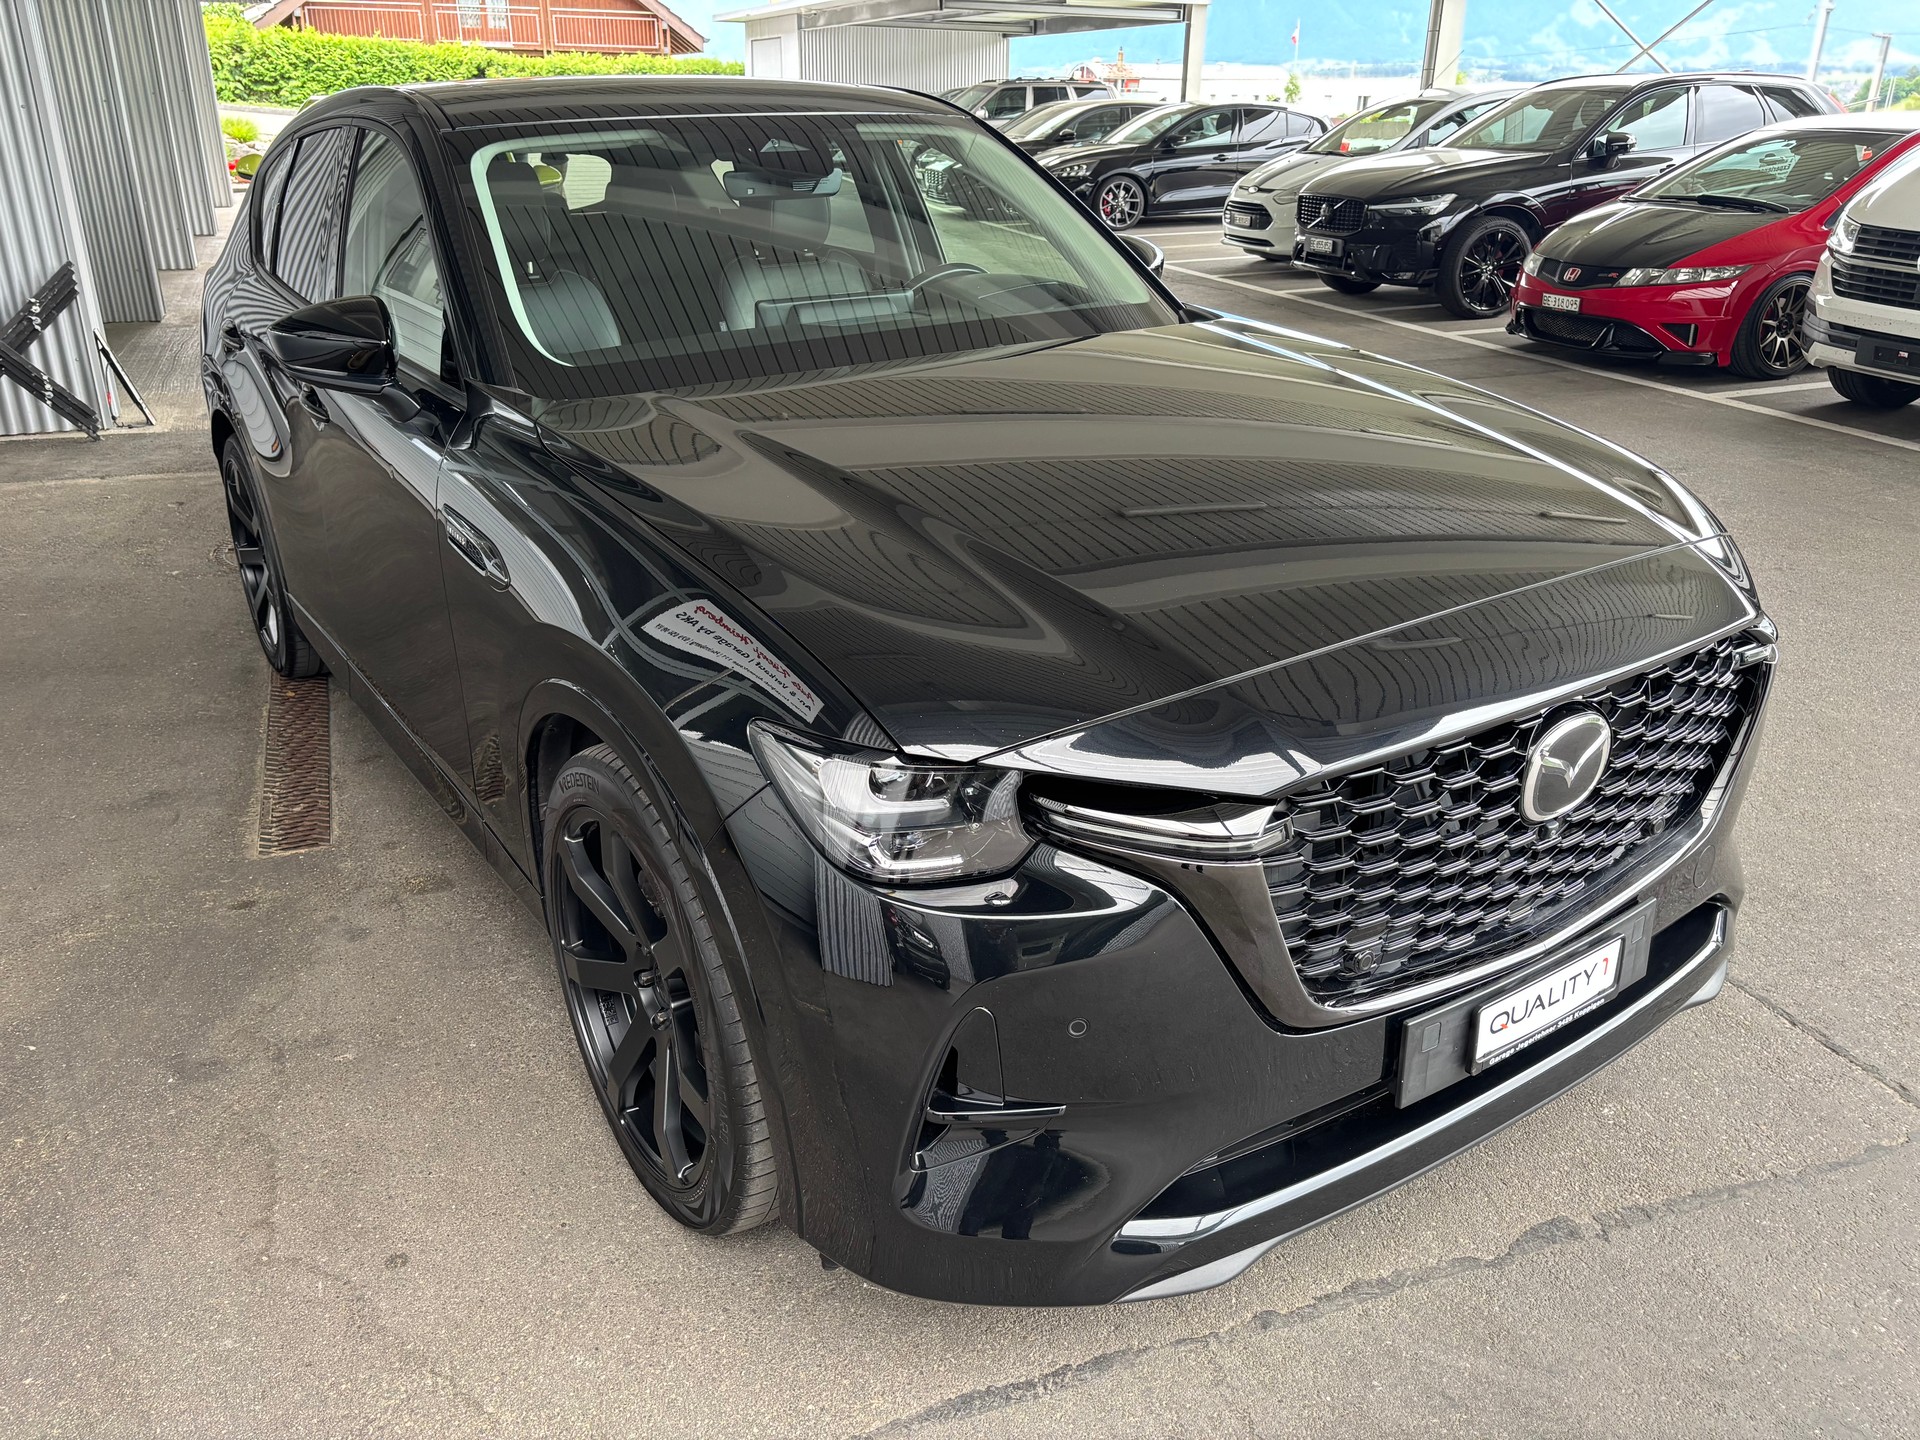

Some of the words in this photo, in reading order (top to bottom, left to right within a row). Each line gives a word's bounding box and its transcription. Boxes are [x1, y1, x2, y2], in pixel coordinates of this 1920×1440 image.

[558, 772, 600, 795] VREDESTEIN
[1489, 961, 1599, 1035] QUALITY
[1488, 1048, 1515, 1065] Garage
